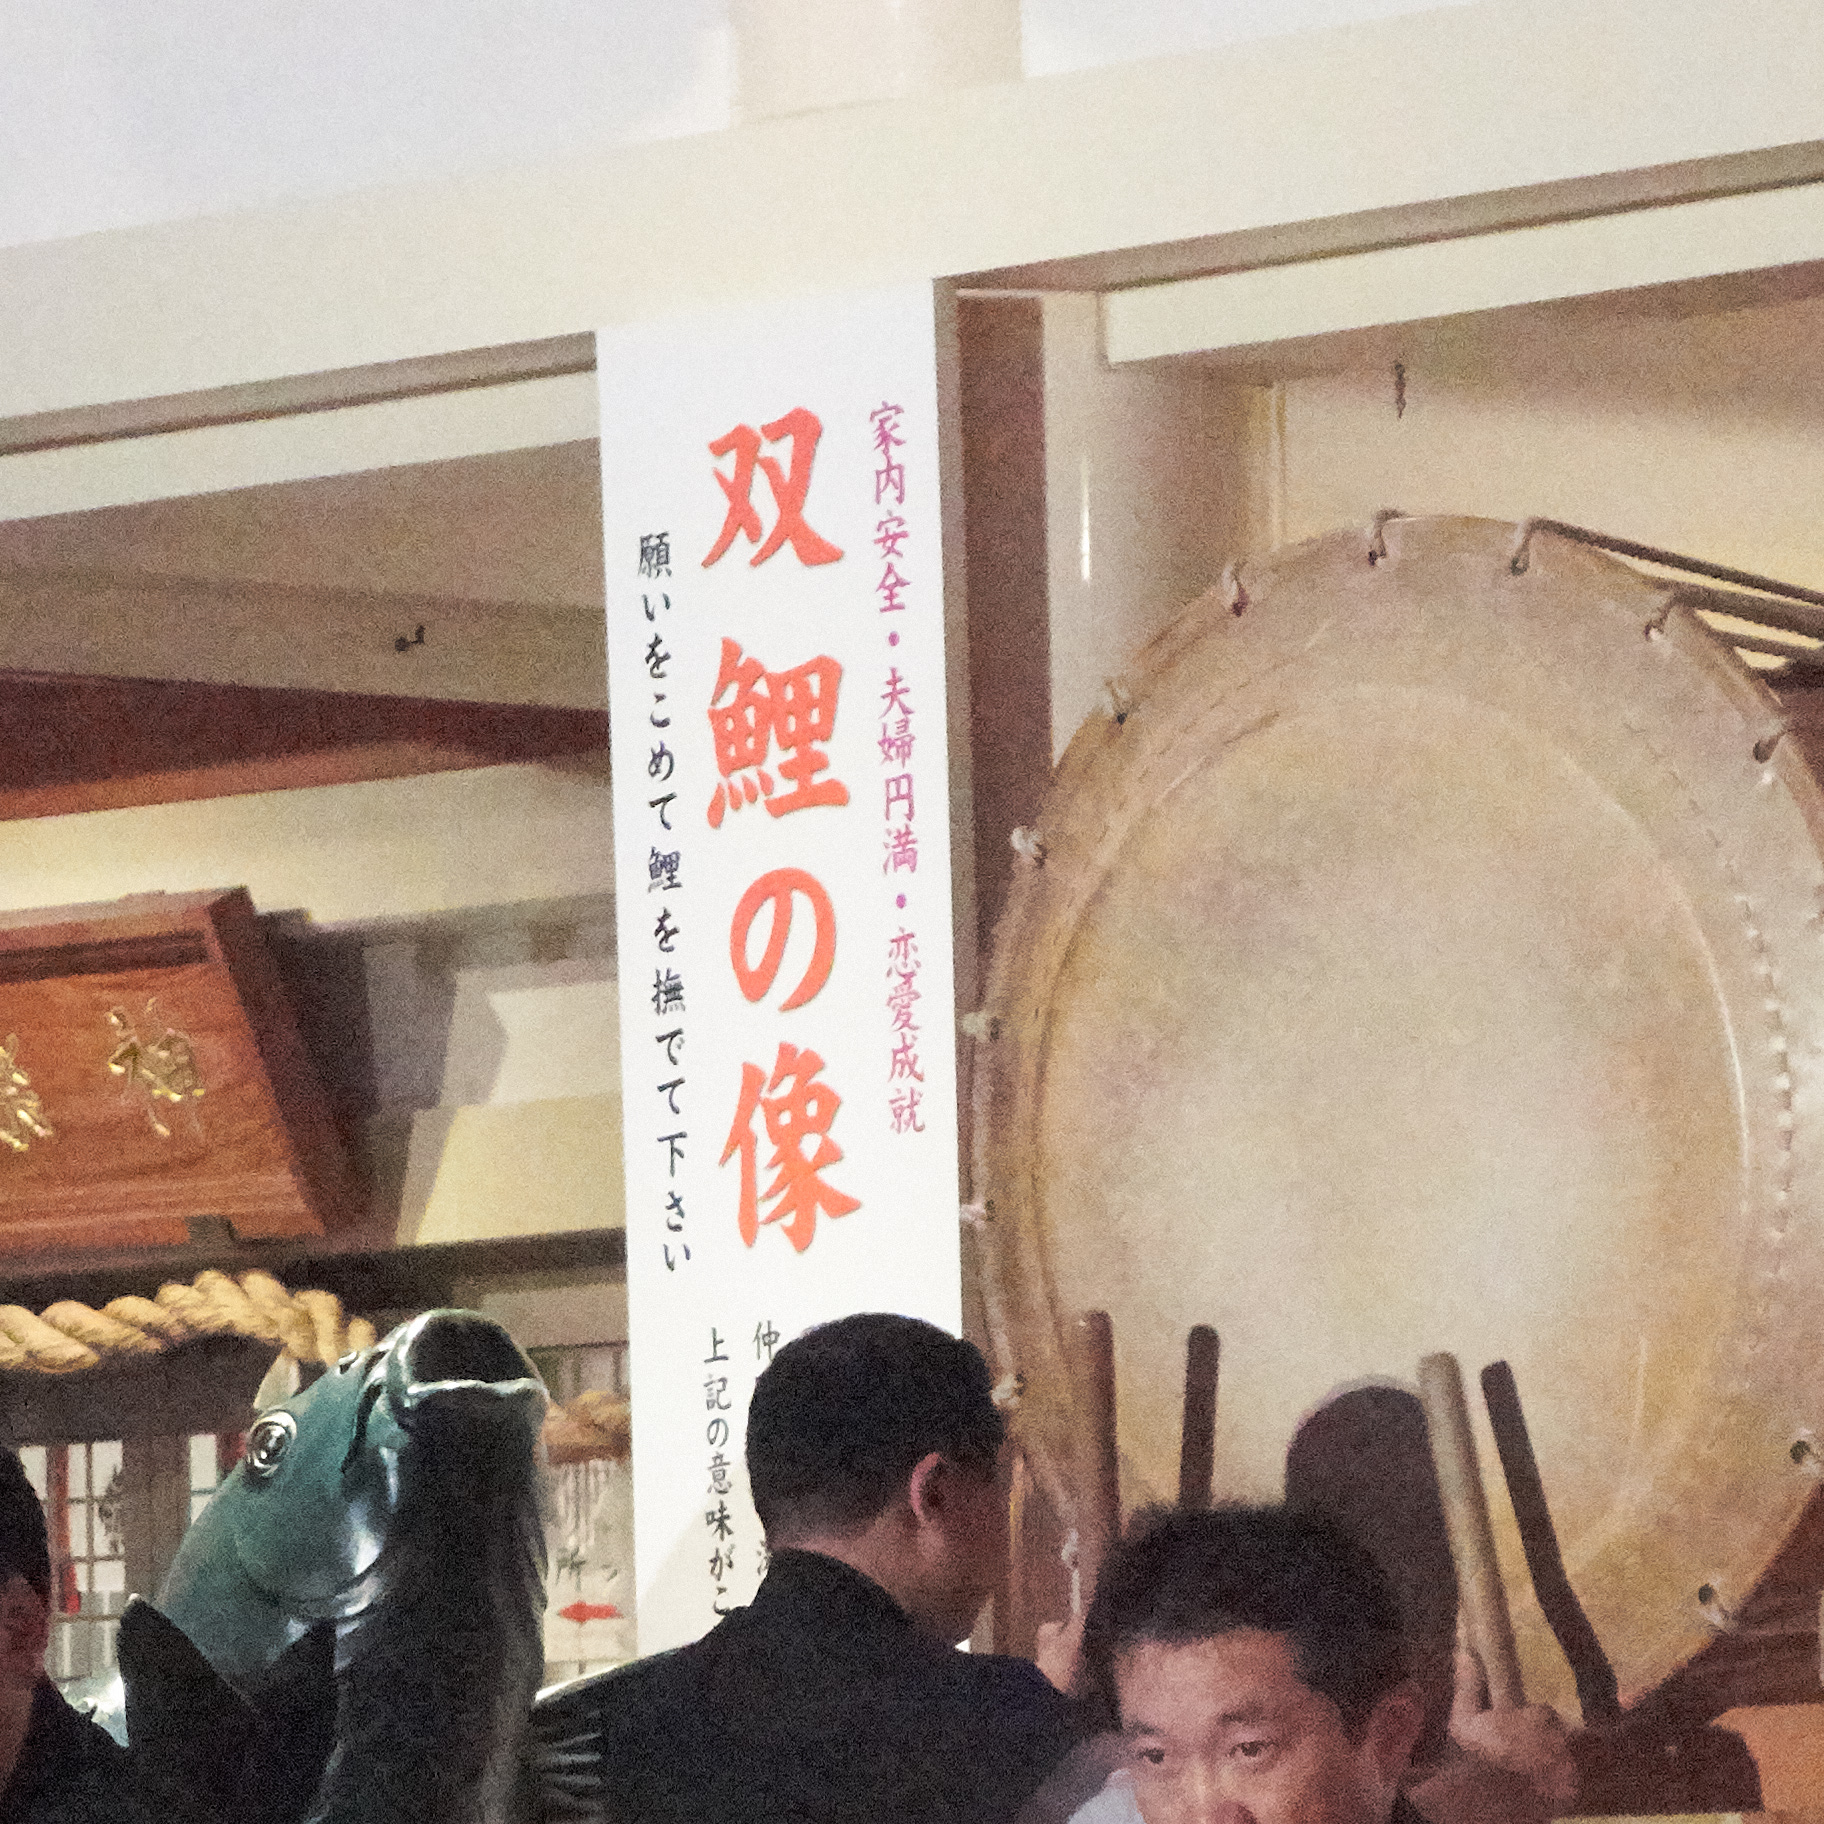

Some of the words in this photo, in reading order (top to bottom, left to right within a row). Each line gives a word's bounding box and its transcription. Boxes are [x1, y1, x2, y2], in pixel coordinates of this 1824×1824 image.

[637, 530, 694, 1272] 願いをこめて鯉を撫でて下さい
[702, 406, 862, 1253] 双鯉の像
[869, 400, 926, 1134] 家内安全・夫婦円満・恋愛成就
